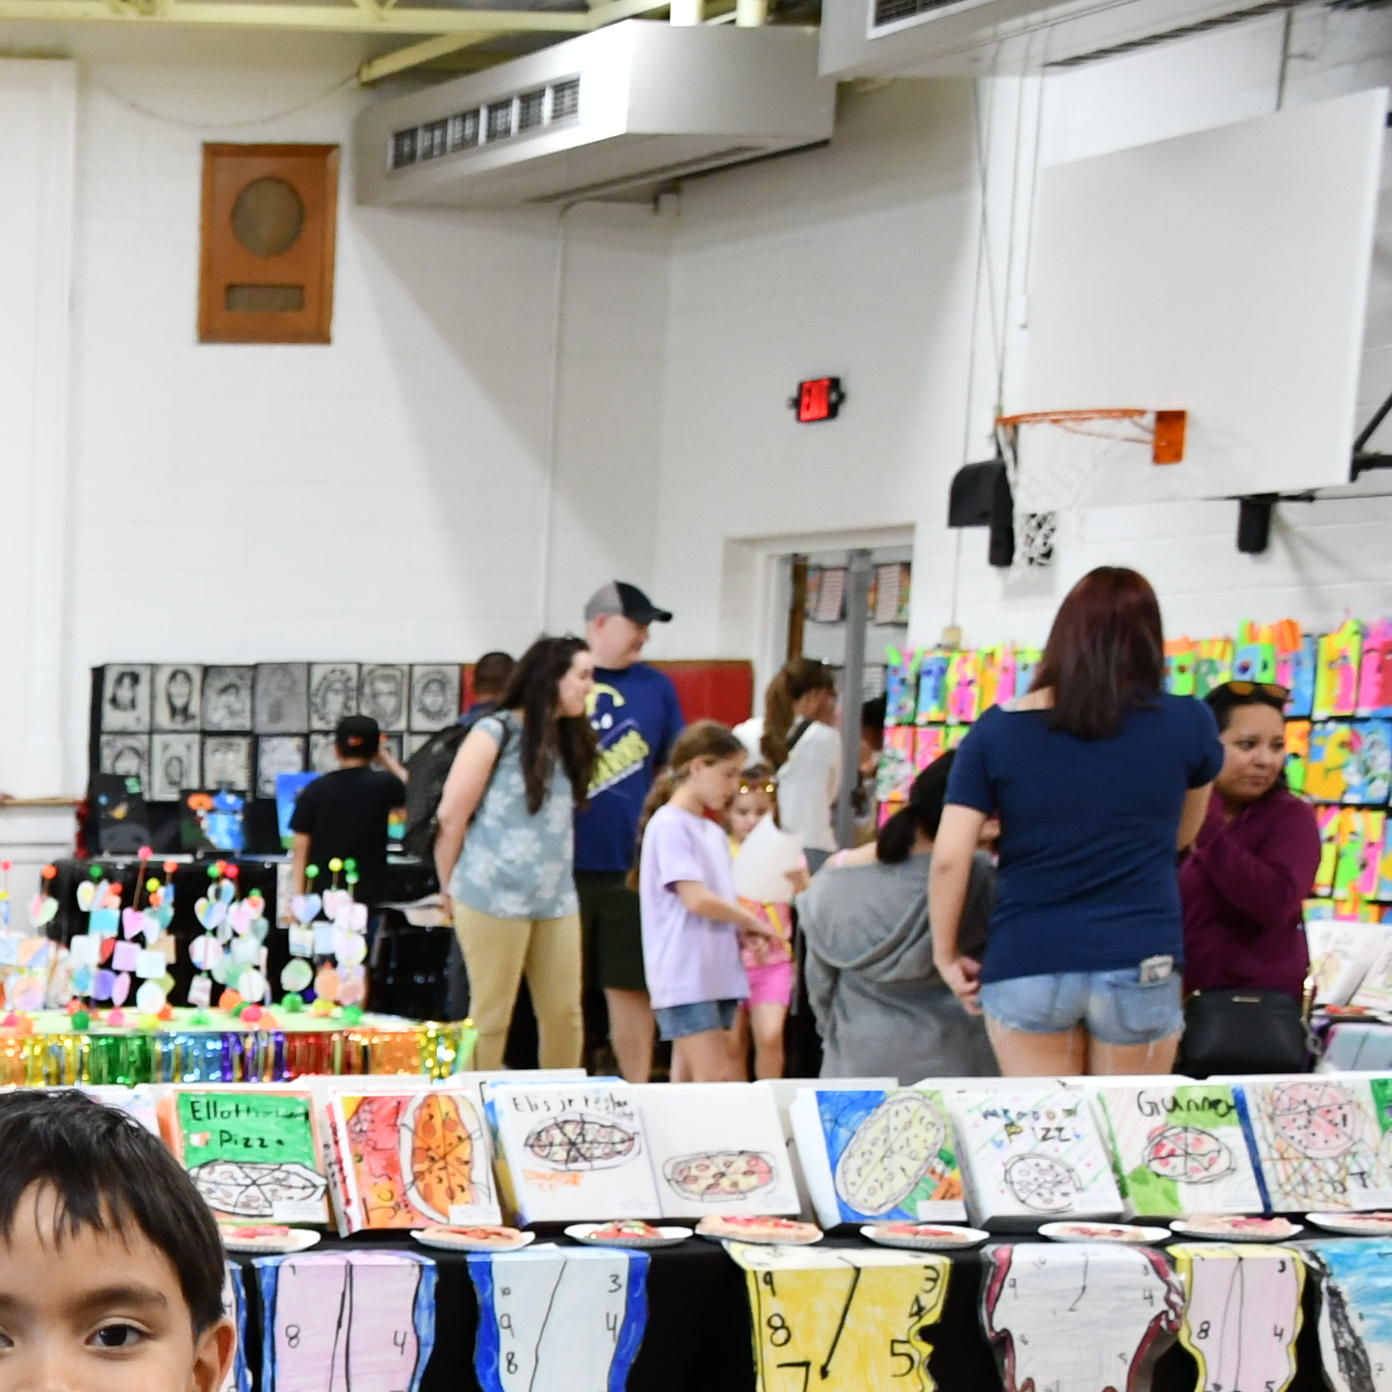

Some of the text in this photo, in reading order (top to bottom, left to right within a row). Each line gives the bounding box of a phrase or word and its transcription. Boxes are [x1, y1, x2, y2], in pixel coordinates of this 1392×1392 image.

[608, 1274, 623, 1293] 3
[285, 1324, 301, 1349] 8
[499, 1313, 516, 1338] 9
[606, 1312, 617, 1342] 4
[767, 1313, 792, 1347] 8
[1196, 1320, 1212, 1340] 8
[1273, 1325, 1284, 1342] 4
[394, 1331, 408, 1356] 4
[506, 1352, 518, 1374] 8
[890, 1339, 915, 1378] 5
